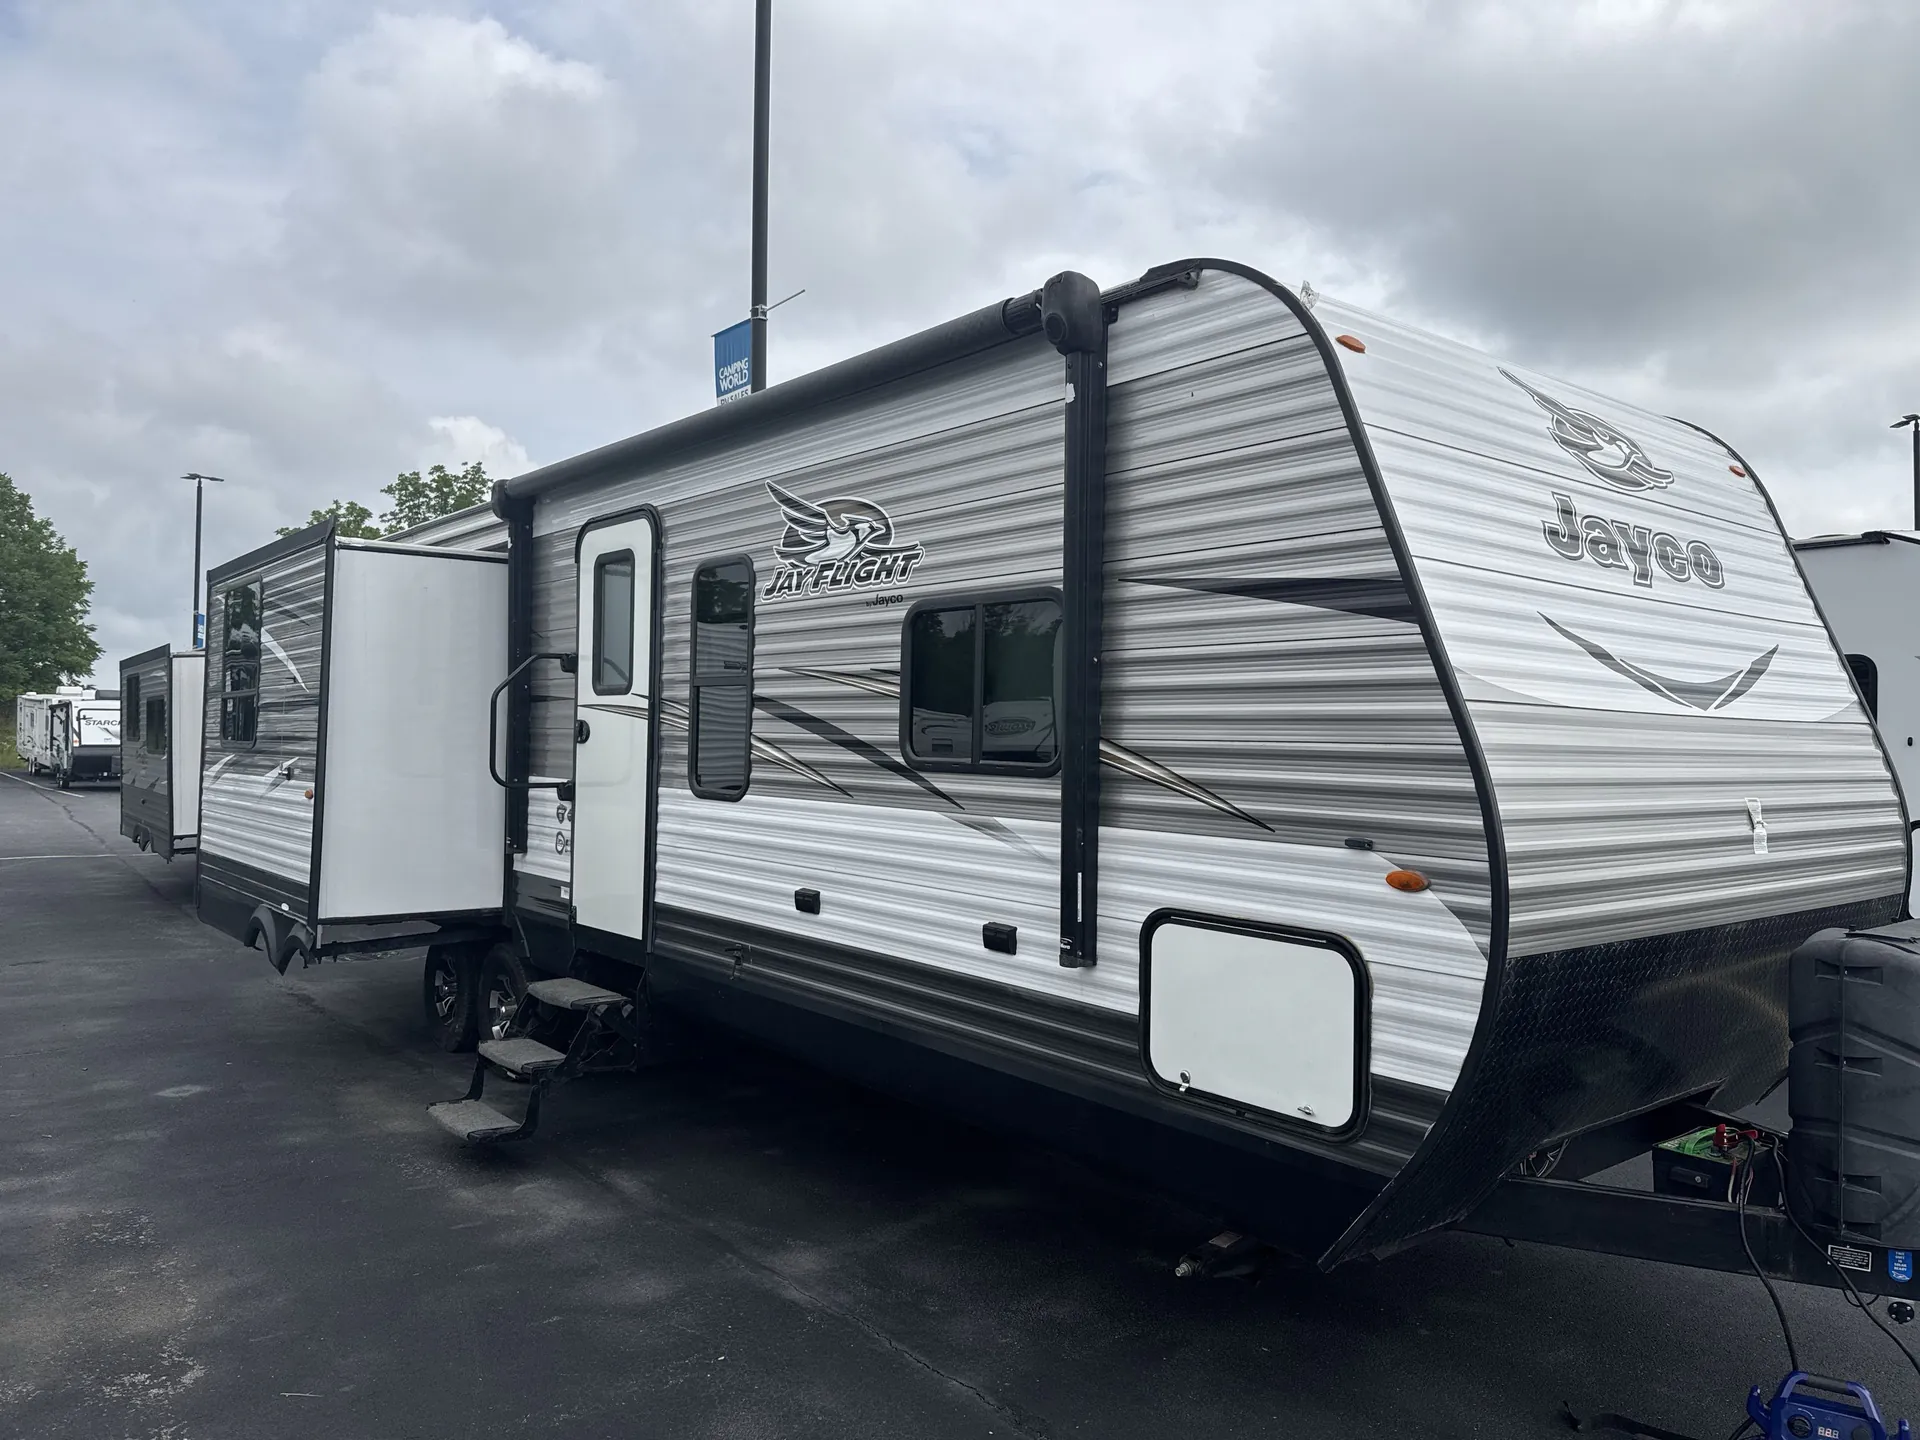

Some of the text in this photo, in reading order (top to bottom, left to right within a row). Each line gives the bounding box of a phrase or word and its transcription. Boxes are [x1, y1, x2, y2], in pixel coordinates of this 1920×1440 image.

[719, 358, 749, 379] CAMPING
[719, 370, 749, 392] WORLD
[1541, 491, 1725, 589] Jayco
[761, 546, 925, 602] JAY FLIGHT
[872, 593, 904, 608] Jayco
